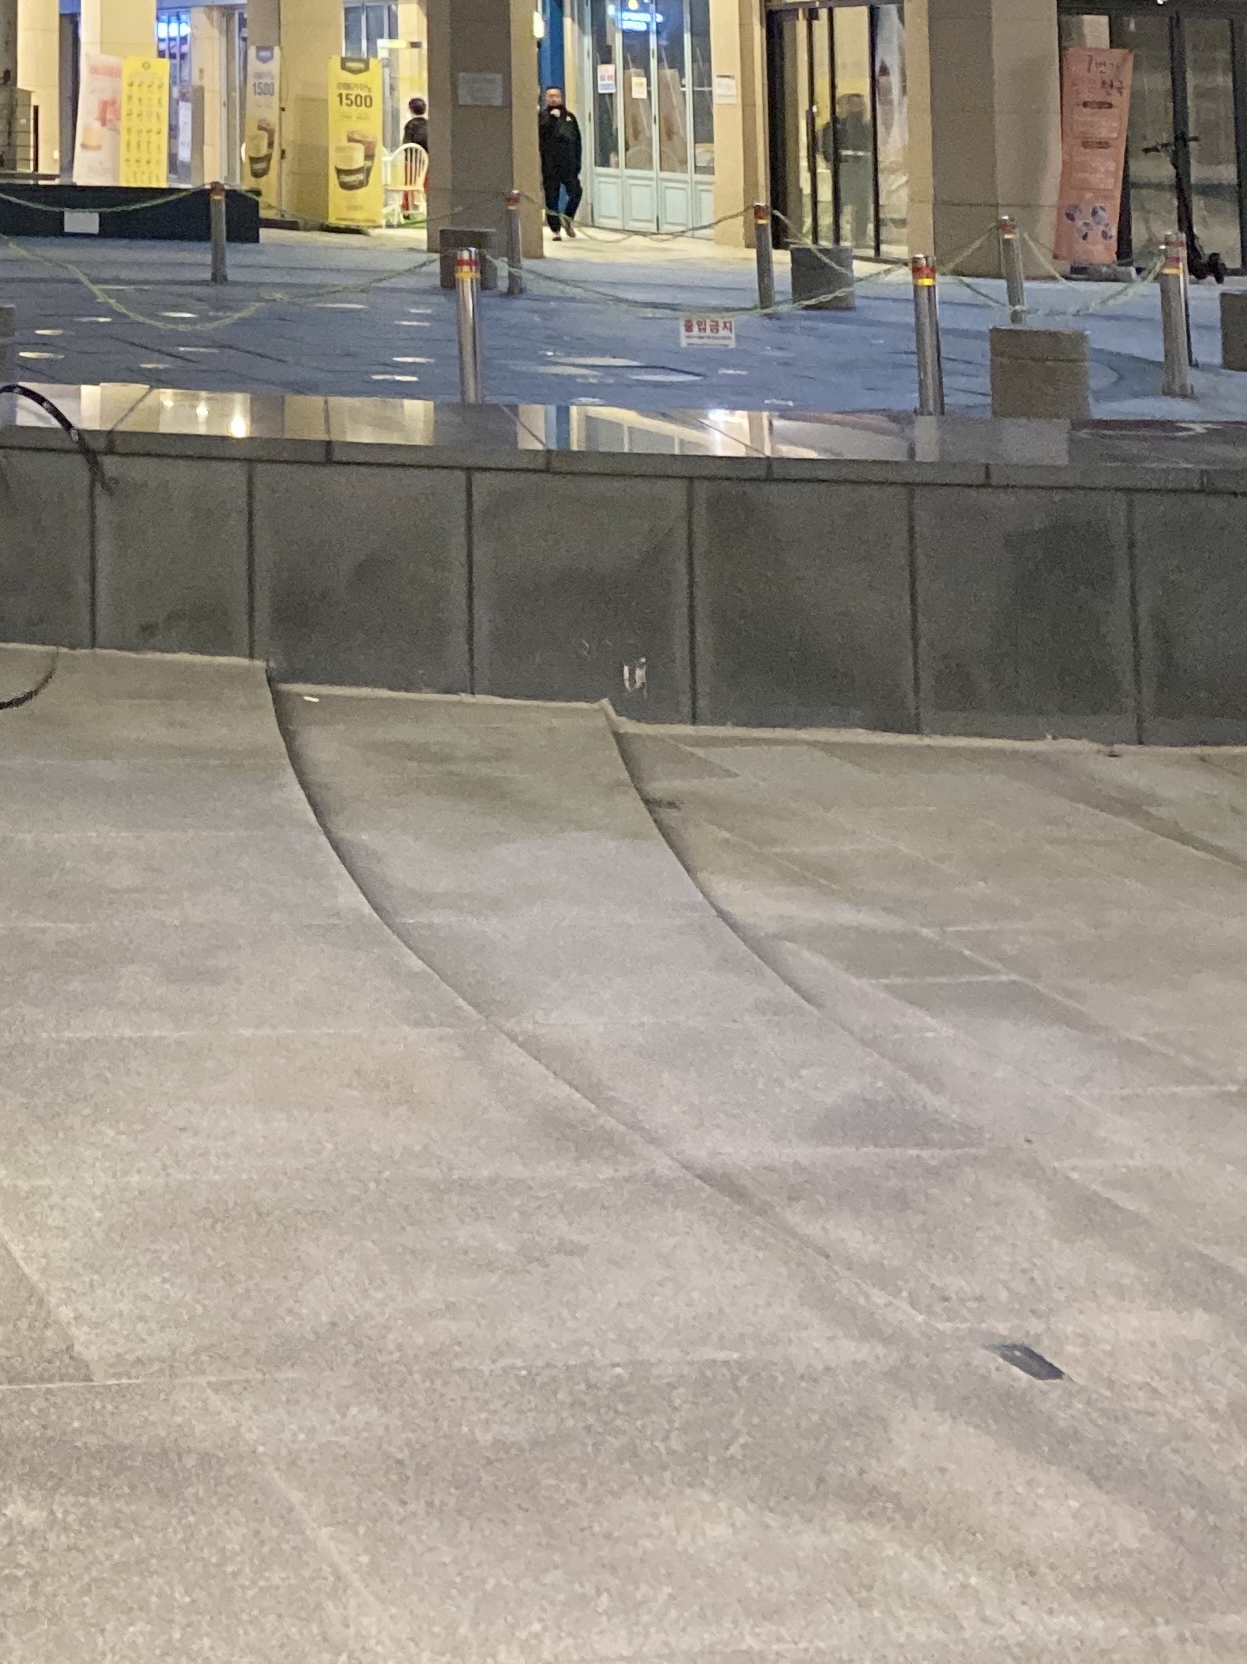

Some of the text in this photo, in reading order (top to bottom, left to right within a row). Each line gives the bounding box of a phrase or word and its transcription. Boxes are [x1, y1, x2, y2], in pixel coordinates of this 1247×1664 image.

[253, 82, 275, 96] 1500
[336, 92, 373, 108] 1500
[683, 319, 733, 334] 출입금지
